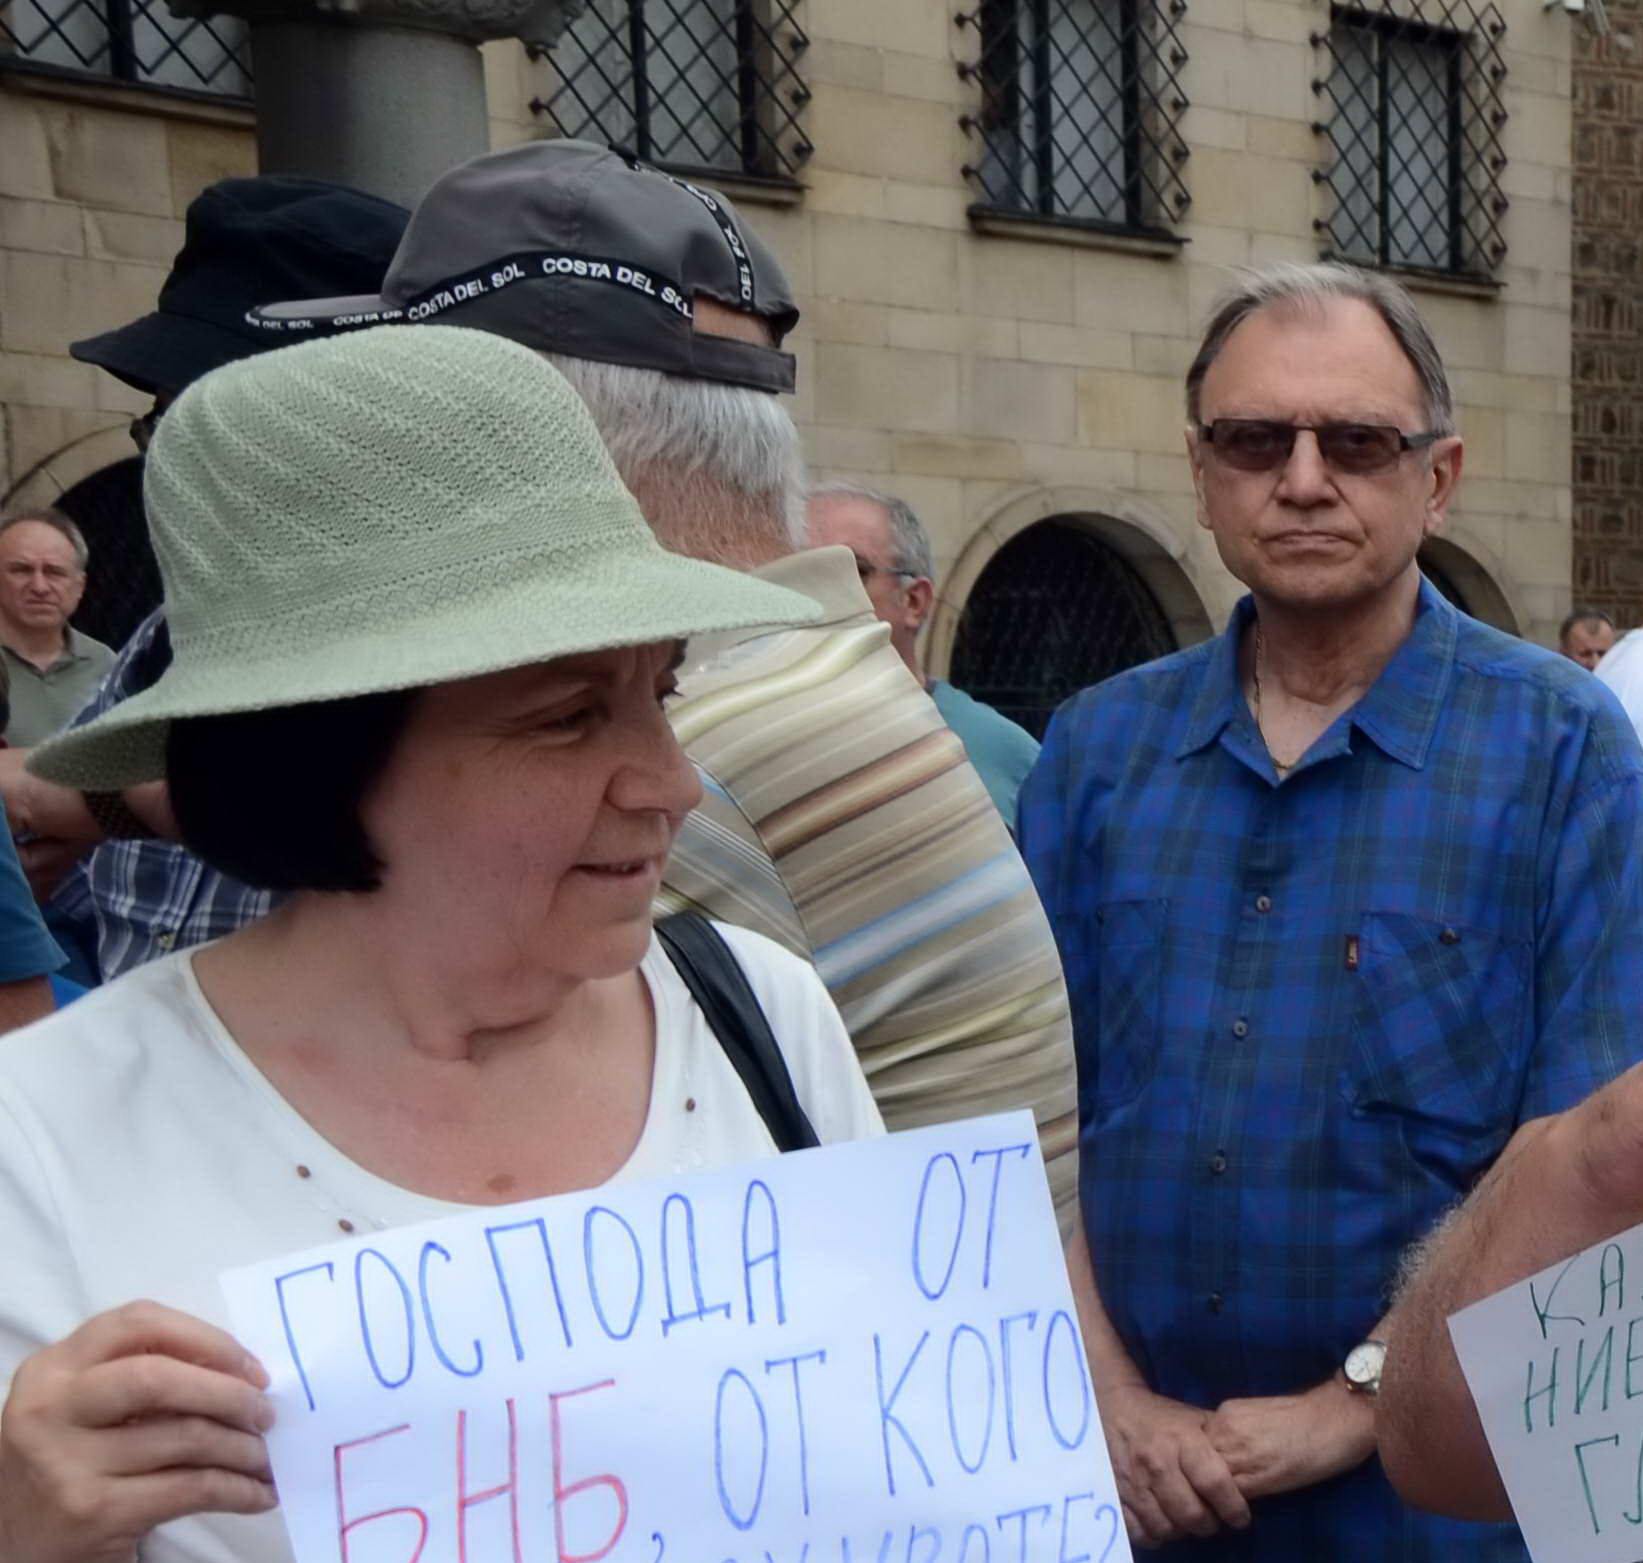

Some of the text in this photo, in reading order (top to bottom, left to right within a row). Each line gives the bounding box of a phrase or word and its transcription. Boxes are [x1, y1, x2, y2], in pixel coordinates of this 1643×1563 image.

[408, 263, 525, 320] COSTA DEL SOL
[542, 257, 611, 279] COSTA
[615, 266, 655, 296] DEL
[275, 1145, 1032, 1410] ГОСПОДА ОТ
[714, 1350, 826, 1532] ОТ
[873, 1309, 1091, 1498] КОГО
